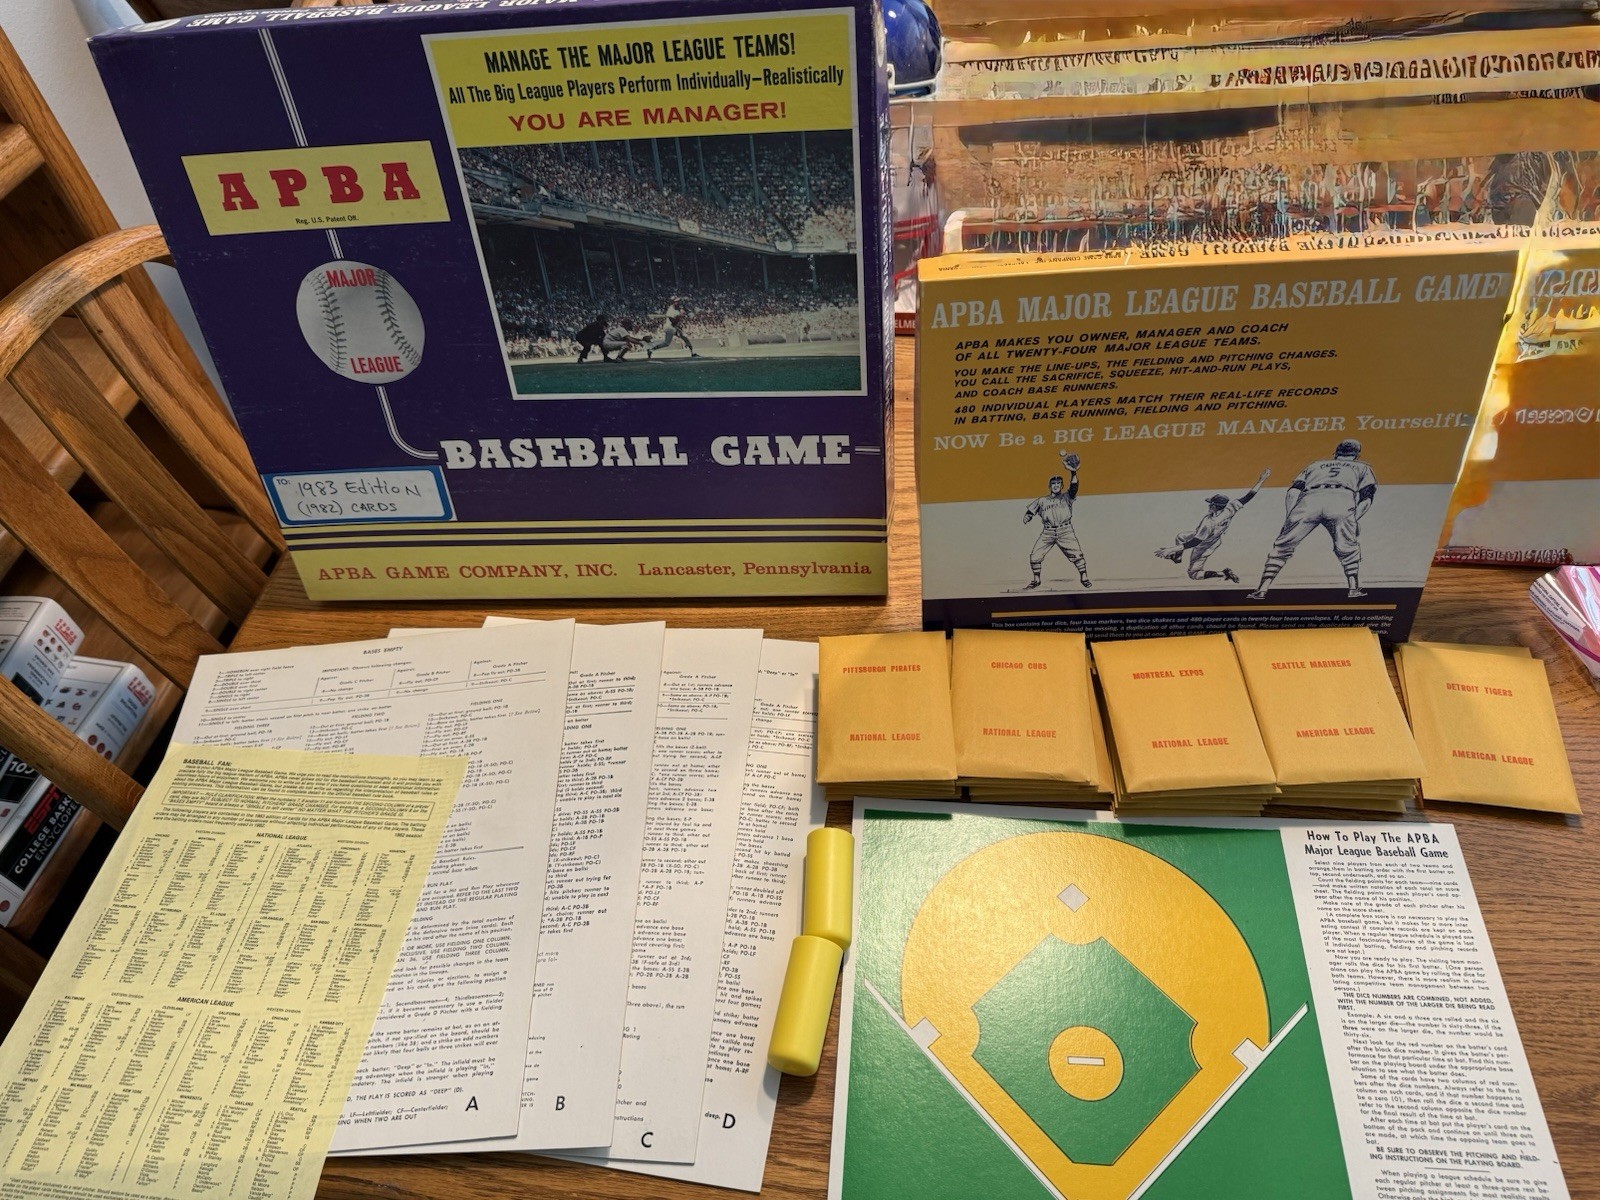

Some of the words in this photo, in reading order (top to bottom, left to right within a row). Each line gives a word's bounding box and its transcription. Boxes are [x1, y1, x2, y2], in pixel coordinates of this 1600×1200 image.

[484, 48, 551, 72] MANAGE
[556, 45, 590, 68] THE
[597, 42, 655, 66] MAJOR
[662, 37, 725, 62] LEAGUE
[733, 32, 794, 57] TEAMS!
[449, 86, 465, 104] All
[466, 85, 491, 102] The
[493, 84, 515, 103] Big
[517, 83, 563, 101] League
[566, 79, 614, 98] Players
[618, 75, 671, 93] Perform
[508, 113, 564, 131] YOU
[578, 109, 631, 127] ARE
[642, 102, 785, 124] MANAGER!
[218, 162, 420, 211] APBA
[326, 268, 378, 287] MAJOR
[931, 299, 1003, 328] APBA
[1017, 292, 1111, 322] MAJOR
[1125, 285, 1238, 315] LEAGUE
[1250, 277, 1400, 309] BASEBALL
[1415, 272, 1500, 302] GAME
[955, 340, 988, 349] APBA
[995, 337, 1040, 347] MAKES
[1048, 335, 1073, 344] YOU
[1079, 332, 1128, 342] OWNER,
[1135, 327, 1201, 338] MANAGER
[1206, 326, 1234, 334] AND
[1241, 323, 1288, 333] COACH
[955, 353, 972, 361] OF
[977, 352, 999, 360] ALL
[1007, 346, 1097, 357] TWENTY-FOUR
[1104, 343, 1150, 352] MAJOR
[1156, 340, 1206, 349] LEAGUE
[1214, 337, 1260, 346] TEAMS.
[350, 356, 403, 374] LEAGUE
[954, 368, 976, 376] YOU
[981, 366, 1014, 375] MAKE
[1046, 362, 1099, 371] LINE-UPS,
[1132, 357, 1184, 366] FIELDING
[1219, 352, 1273, 361] PITCHING
[1278, 349, 1337, 359] CHANGES.
[1042, 372, 1103, 381] SACRIFICE,
[1109, 369, 1163, 378] SQUEEZE,
[1169, 365, 1246, 374] HIT-AND-RUN
[1250, 362, 1290, 370] PLAYS,
[954, 390, 977, 398] AND
[983, 387, 1023, 396] COACH
[1027, 385, 1058, 394] BASE
[1063, 381, 1117, 391] RUNNERS.
[954, 405, 975, 413] 480
[981, 401, 1049, 411] INDIVIDUAL
[1055, 398, 1111, 407] PLAYERS
[1116, 395, 1163, 404] MATCH
[1170, 393, 1204, 401] THEIR
[1210, 390, 1273, 399] REAL-LIFE
[1278, 386, 1338, 396] RECORDS
[971, 413, 1025, 423] BATTING,
[1032, 410, 1065, 419] BASE
[1070, 407, 1127, 417] RUNNING,
[1134, 404, 1188, 414] FIELDING
[1194, 403, 1221, 411] AND
[1226, 400, 1286, 409] PITCHING.
[934, 434, 989, 450] NOW
[999, 432, 1025, 446] Be
[1032, 434, 1044, 444] a
[1053, 428, 1093, 443] BIG
[1103, 423, 1205, 440] LEAGUE
[1216, 416, 1345, 435] MANAGER
[440, 436, 688, 469] BASEBALL
[711, 435, 850, 465] GAME
[1329, 468, 1340, 477] 5
[298, 480, 337, 496] 1983
[297, 502, 342, 517] (1982)
[351, 502, 397, 512] CARDS
[318, 567, 376, 580] APBA
[385, 566, 449, 578] GAME
[459, 564, 568, 578] COMPANY,
[575, 563, 616, 576] INC.
[637, 563, 735, 576] Lancaster,
[742, 562, 872, 577] Pennsylvania
[1271, 661, 1306, 669] SEATTLE
[1309, 660, 1351, 668] MARINERS
[1132, 670, 1174, 679] MONTREAL
[1446, 682, 1478, 692] DETROIT
[1484, 687, 1512, 696] TIGERS
[983, 728, 1020, 736] NATIONAL
[1026, 729, 1056, 738] LEAGUE
[1296, 728, 1339, 737] AMERICAN
[1343, 727, 1375, 735] LEAGUE
[1152, 739, 1192, 748] NATIONAL
[1197, 737, 1228, 746] LEAGUE
[1452, 750, 1496, 761] AMERICAN
[1501, 755, 1534, 765] LEAGUE
[14, 826, 50, 874] COLLEGE
[49, 794, 73, 824] BASK
[1306, 830, 1329, 840] How
[1334, 831, 1348, 841] To
[1353, 831, 1375, 844] Play
[1380, 832, 1400, 842] The
[1407, 833, 1439, 843] APBA
[1305, 844, 1332, 856] Major
[1337, 845, 1371, 857] League
[1375, 846, 1416, 856] Baseball
[1420, 847, 1448, 858] Game
[465, 1096, 479, 1111] A
[555, 1096, 566, 1110] B
[722, 1113, 736, 1129] D
[641, 1132, 653, 1148] C
